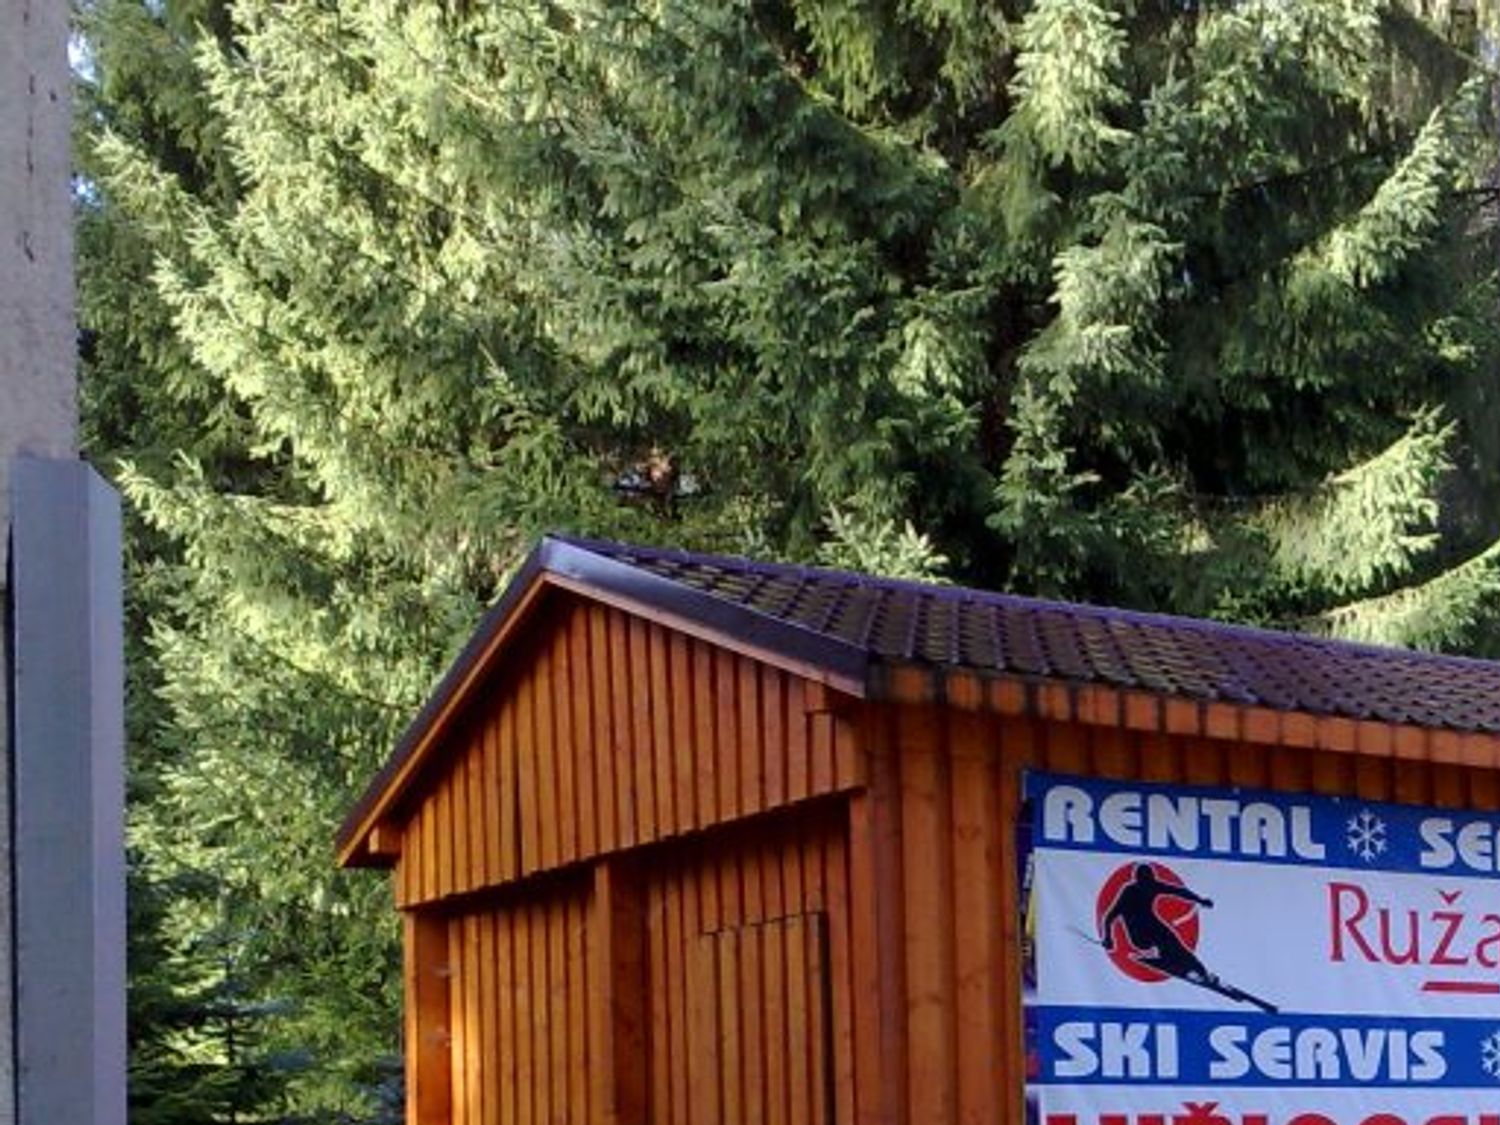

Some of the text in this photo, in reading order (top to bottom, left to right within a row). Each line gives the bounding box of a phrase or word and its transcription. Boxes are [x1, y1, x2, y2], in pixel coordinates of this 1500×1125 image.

[1043, 785, 1325, 860] RENTAL
[1053, 1021, 1180, 1078] SKI
[1209, 1025, 1447, 1081] SERVIS
